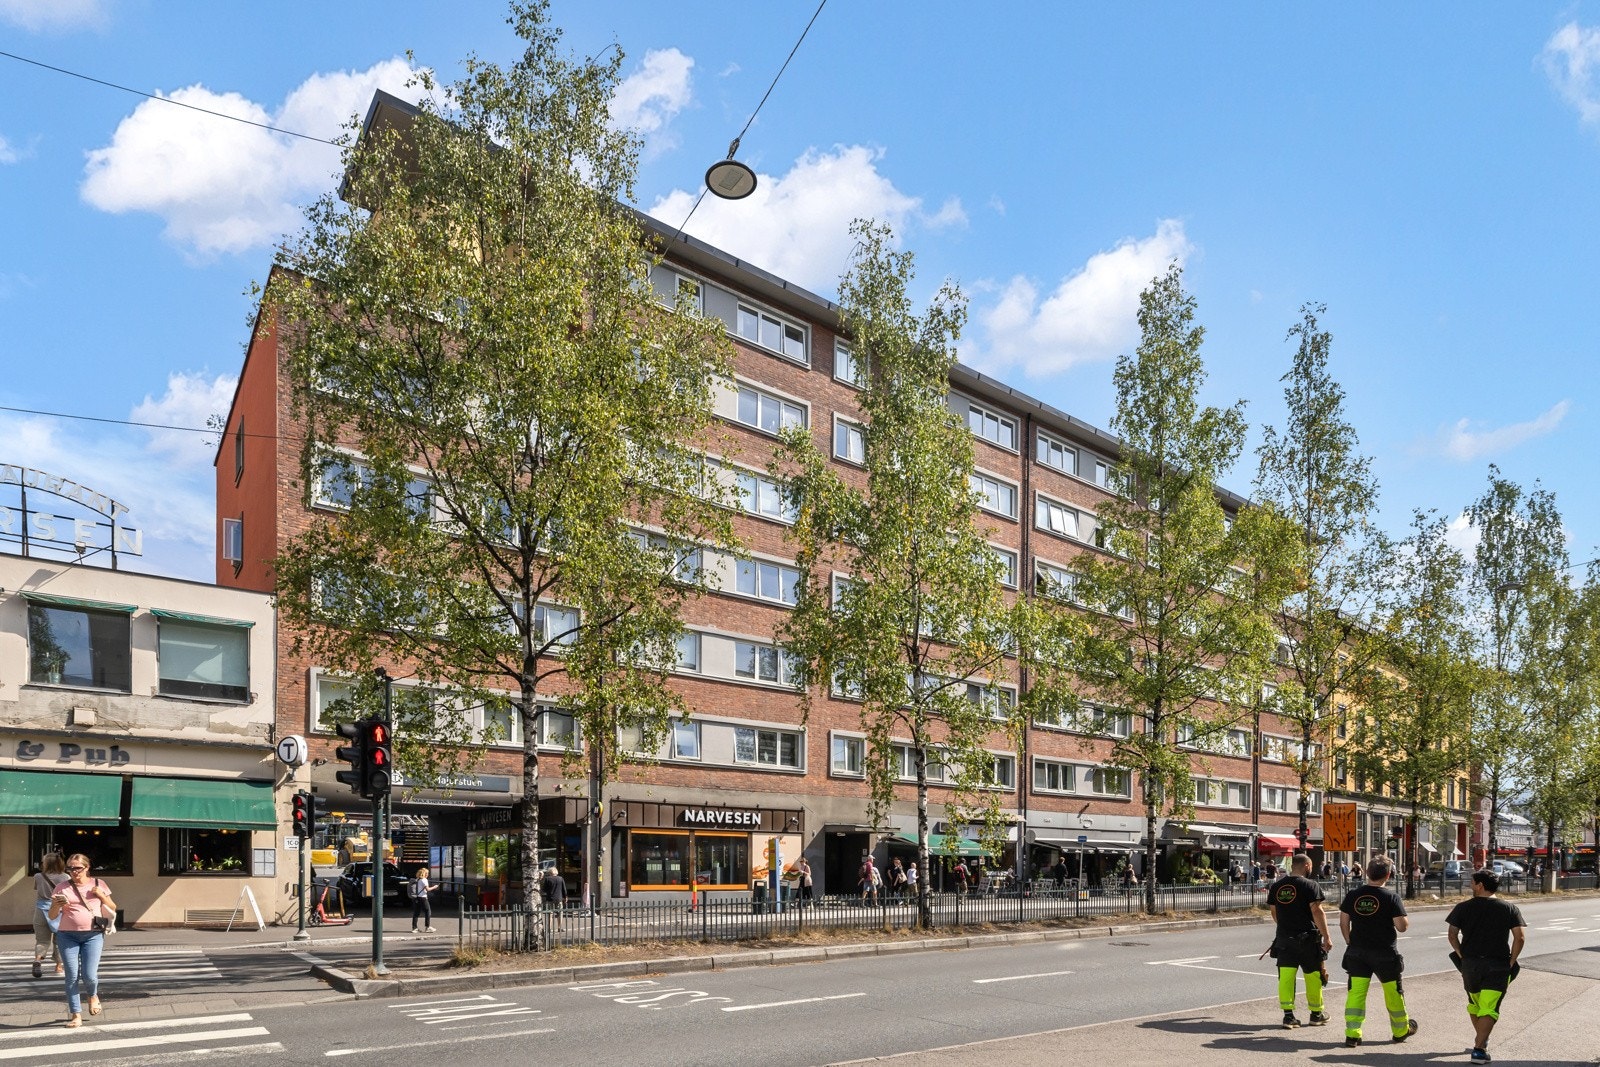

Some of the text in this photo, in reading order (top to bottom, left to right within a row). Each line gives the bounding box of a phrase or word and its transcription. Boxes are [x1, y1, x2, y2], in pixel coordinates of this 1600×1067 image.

[17, 740, 130, 764] & Pub
[283, 744, 294, 759] T
[685, 810, 761, 825] NARVESEN
[387, 994, 558, 1031] TAXI
